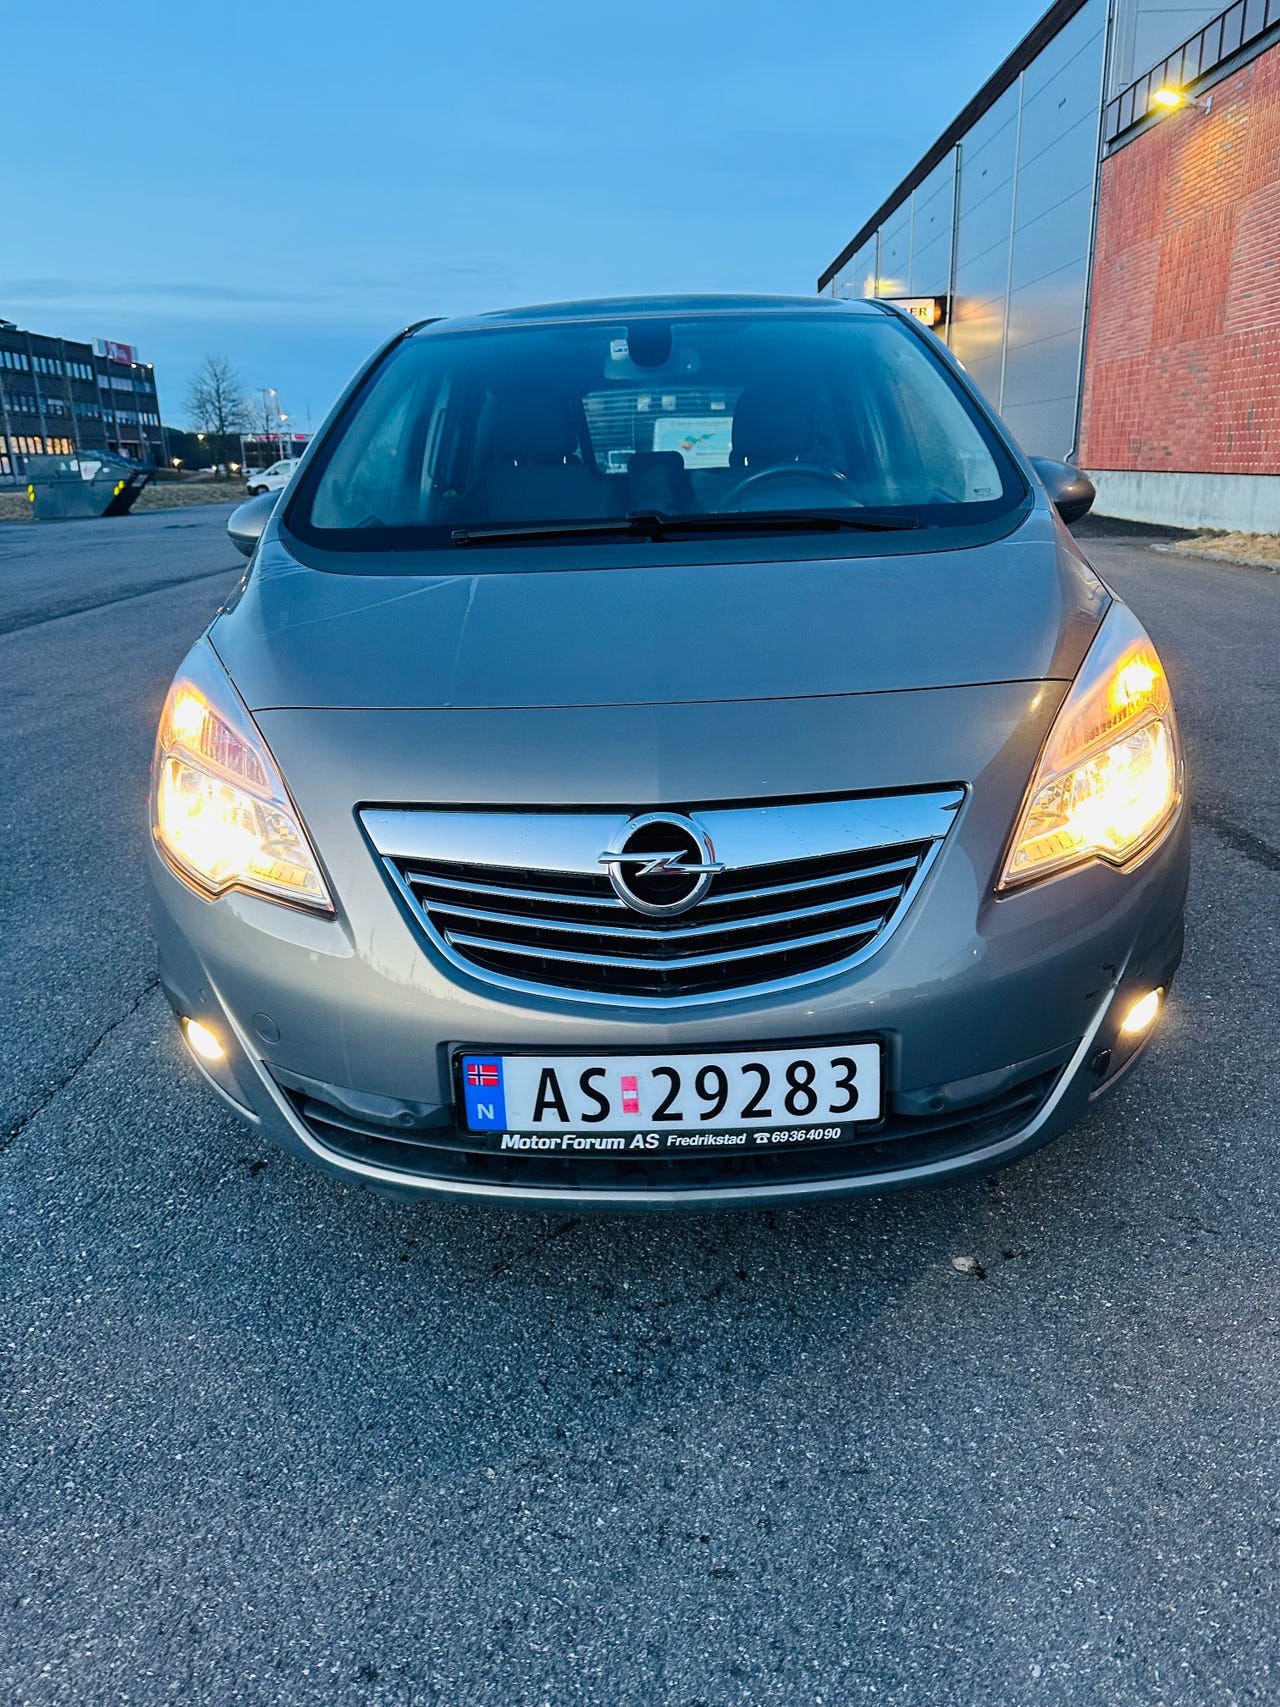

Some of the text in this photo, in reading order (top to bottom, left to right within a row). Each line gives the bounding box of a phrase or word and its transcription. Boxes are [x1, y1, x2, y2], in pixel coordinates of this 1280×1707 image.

[532, 1057, 859, 1123] AS 29283
[477, 1103, 494, 1120] N
[500, 1134, 626, 1150] MotorForum
[629, 1133, 660, 1149] AS
[666, 1133, 747, 1147] Fredrikstad
